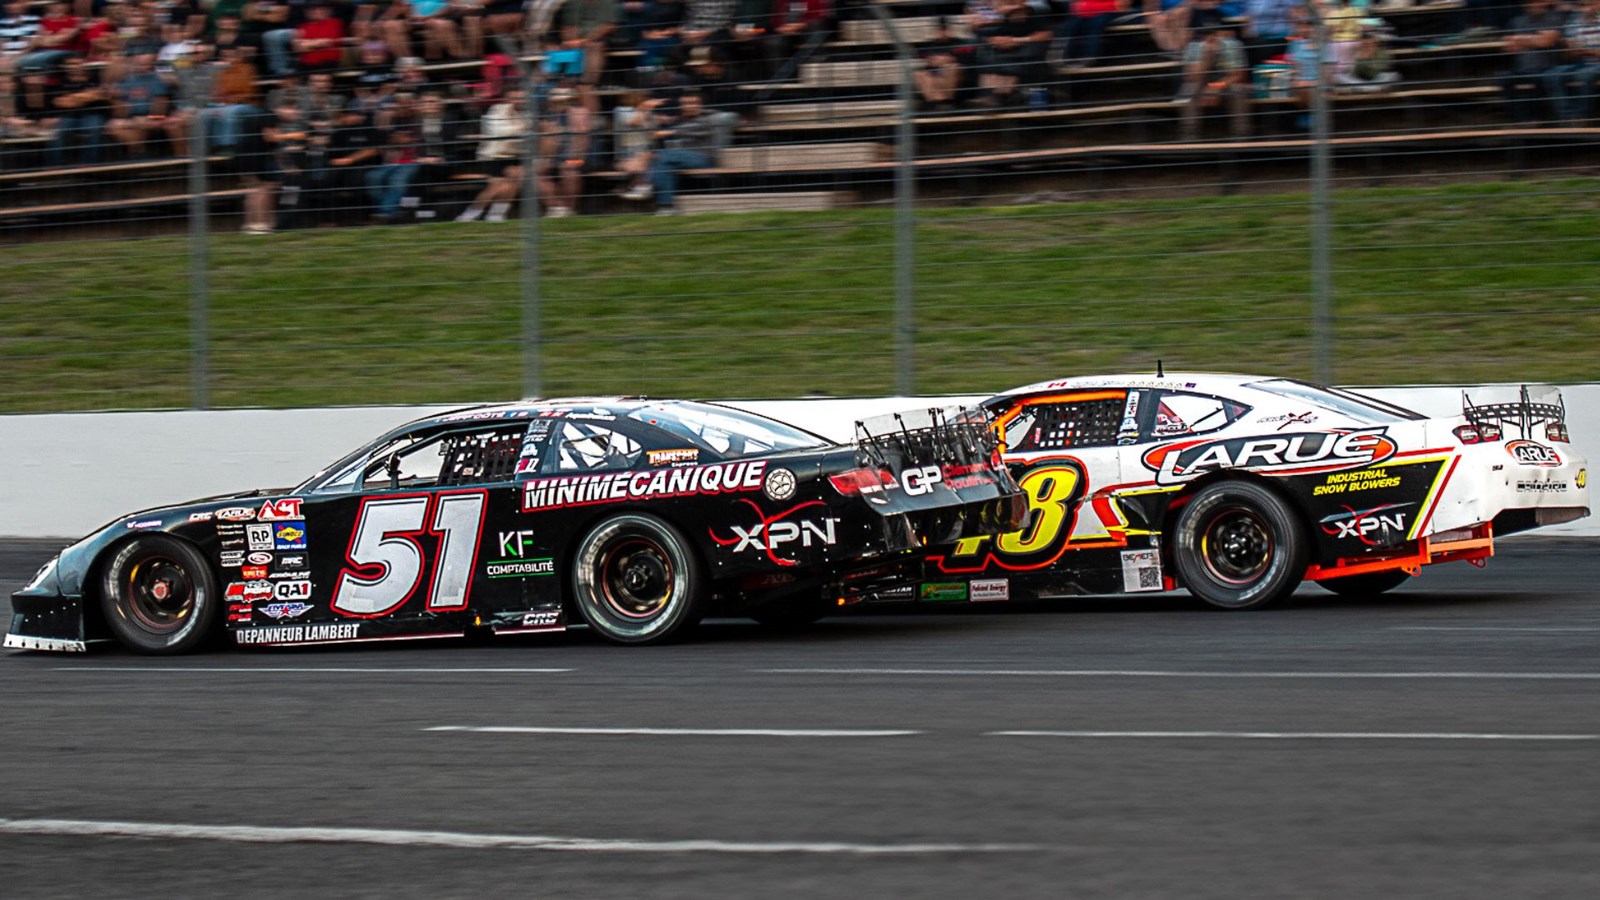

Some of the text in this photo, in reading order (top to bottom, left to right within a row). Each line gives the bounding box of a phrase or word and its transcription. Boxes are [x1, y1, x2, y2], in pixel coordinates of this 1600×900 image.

[1157, 427, 1387, 485] LARUE
[1313, 477, 1401, 496] SNOW BLOWERS
[1327, 469, 1387, 484] INDUSTRIAL
[252, 530, 269, 542] RP
[729, 518, 837, 552] XPN
[1334, 513, 1405, 538] XPN
[499, 530, 534, 557] KF
[332, 492, 487, 617] 51
[486, 560, 554, 575] COMPTABILITÉ
[278, 583, 309, 597] QA1
[236, 623, 360, 644] DEPANNEUR LAMBERT
